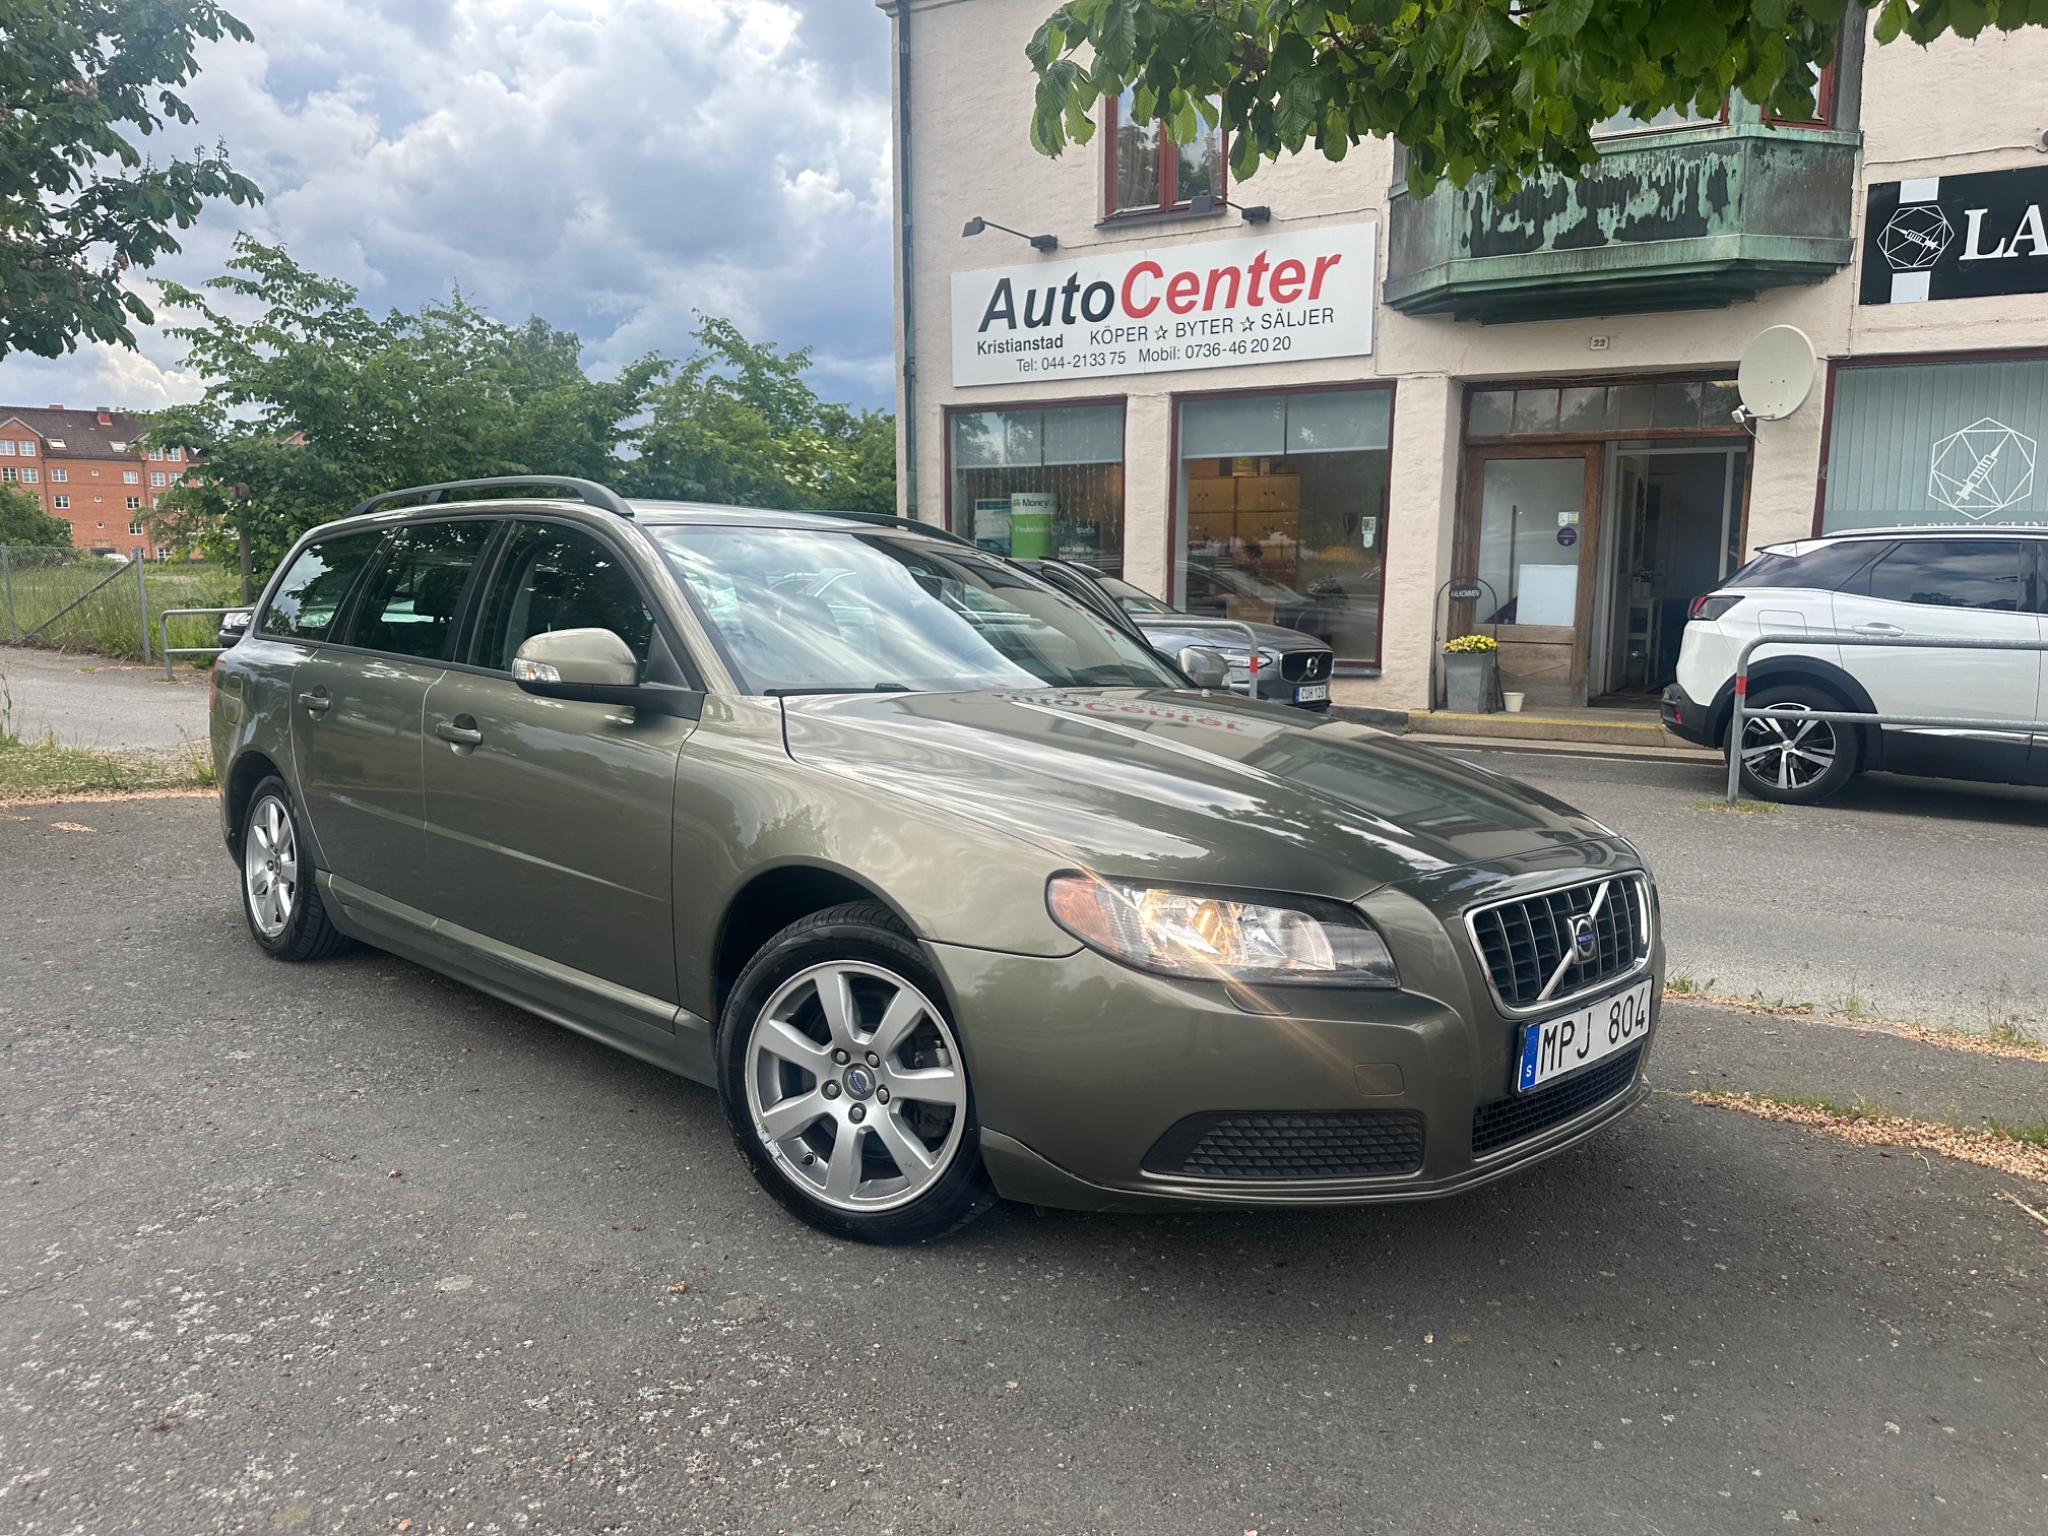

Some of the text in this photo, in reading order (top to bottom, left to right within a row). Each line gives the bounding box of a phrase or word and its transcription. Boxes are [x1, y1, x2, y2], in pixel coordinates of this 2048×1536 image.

[1959, 204, 2048, 260] LA
[977, 249, 1342, 333] AutoCenter
[1090, 308, 1334, 346] KÖPER BYTER SÄLJER
[1593, 338, 1605, 347] 22
[977, 333, 1064, 355] Kristianstad
[1017, 358, 1038, 372] Tel:
[1139, 346, 1181, 363] Mobil:
[1540, 988, 1646, 1077] MPJ 804
[1525, 1064, 1533, 1078] S
